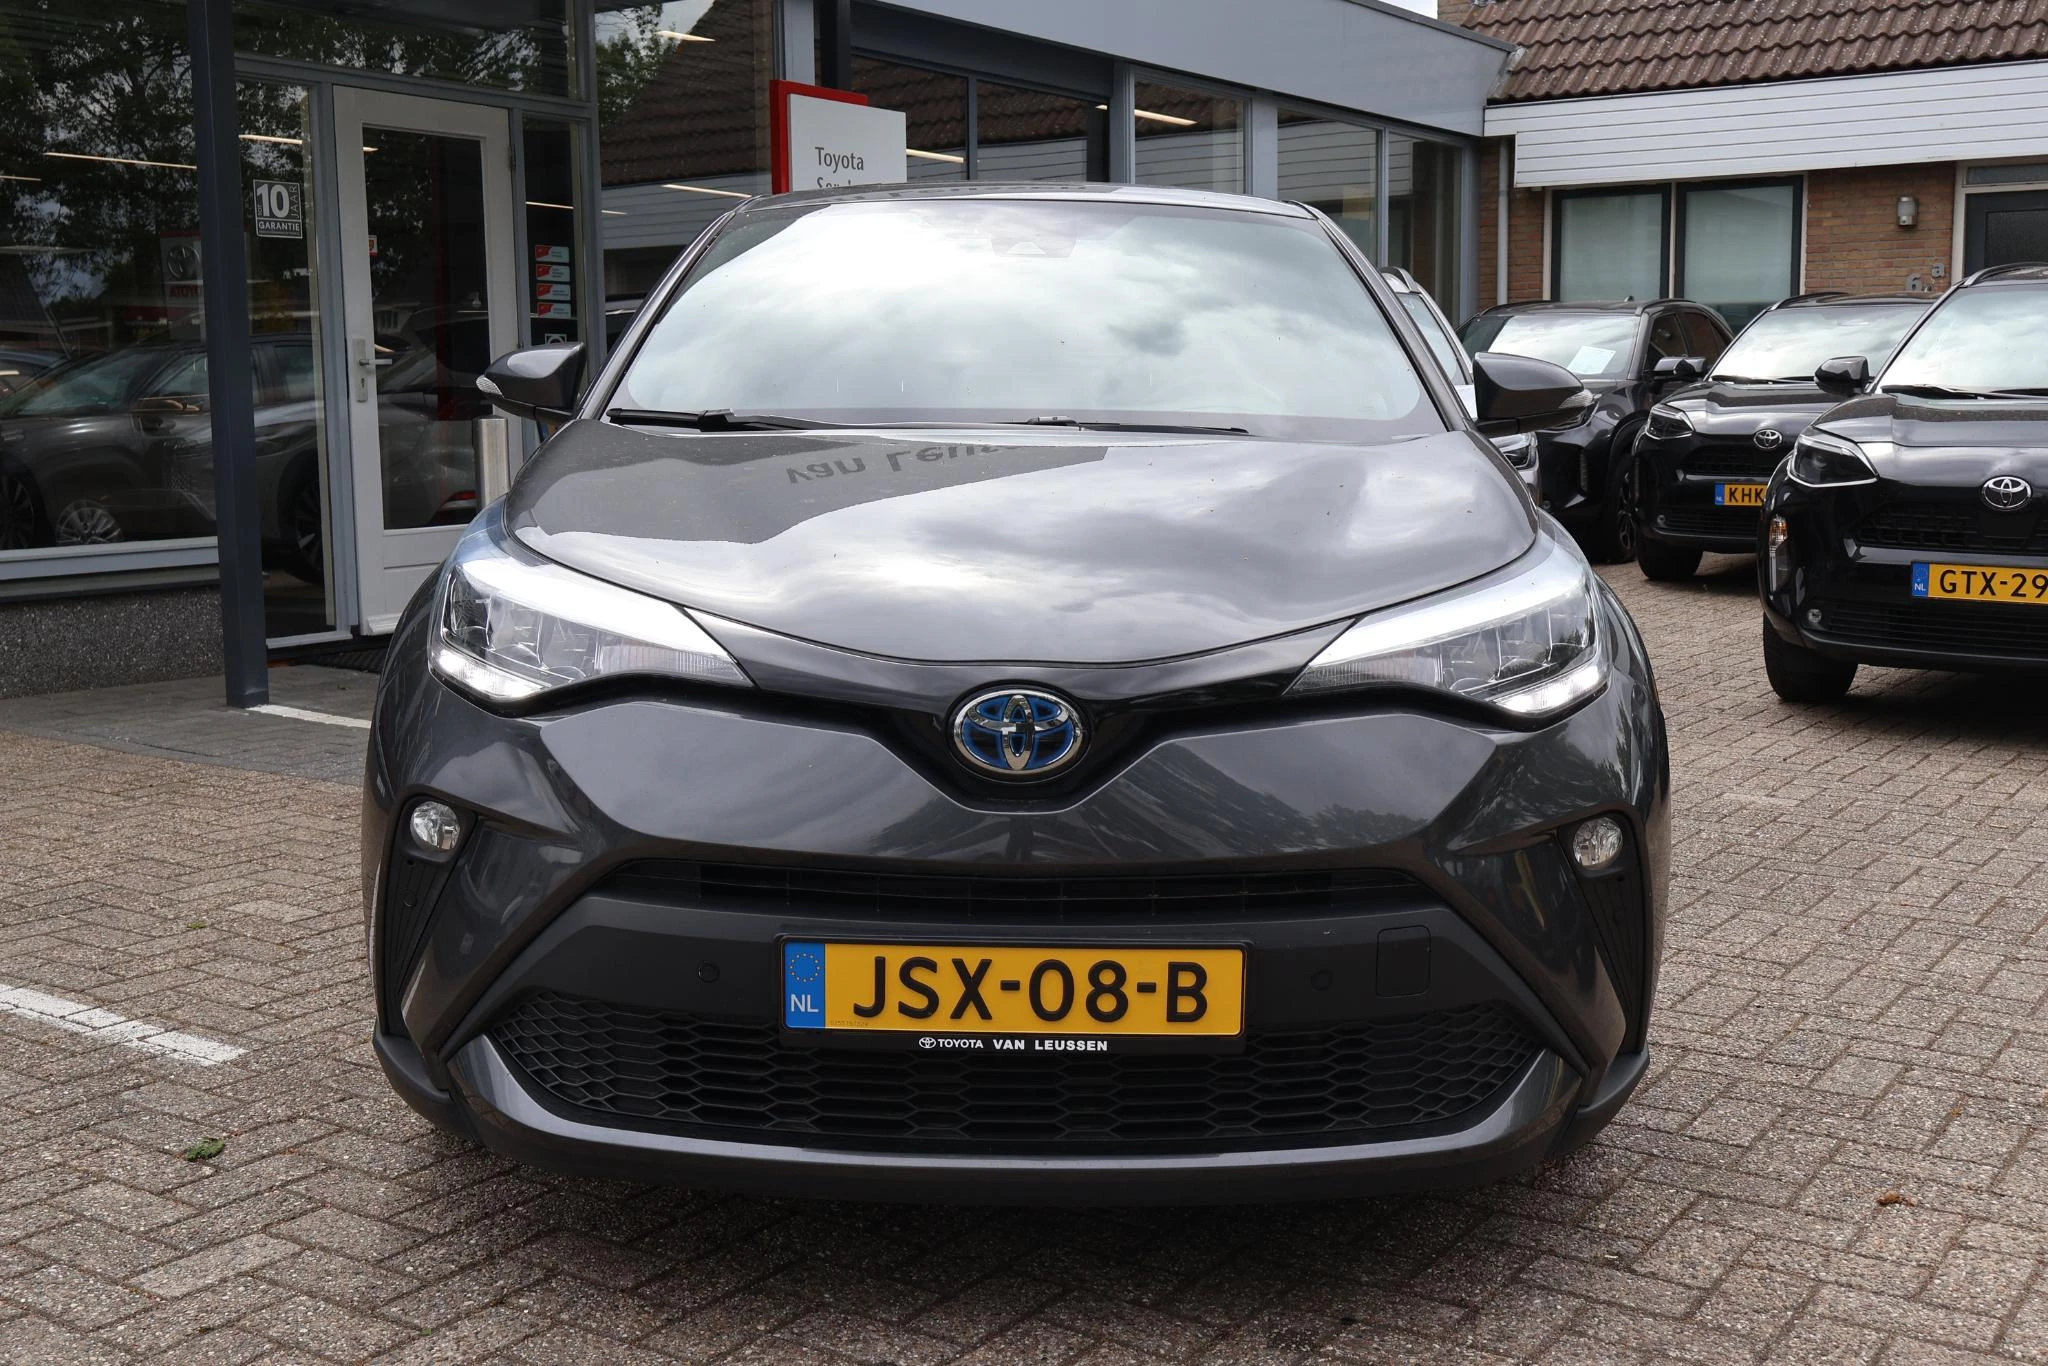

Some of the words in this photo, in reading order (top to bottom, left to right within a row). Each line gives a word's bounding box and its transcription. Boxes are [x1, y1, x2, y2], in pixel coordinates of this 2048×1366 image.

[814, 146, 865, 174] Toyota
[256, 183, 290, 218] 10
[290, 184, 300, 219] JAAR
[258, 220, 300, 232] GARANTIE
[1729, 487, 1765, 503] KHK
[1914, 582, 1926, 591] NL
[1940, 569, 2048, 598] GTX-29
[853, 956, 1208, 1023] JSX-08-B
[790, 993, 819, 1013] NL
[938, 1038, 984, 1049] TOYOTA
[992, 1039, 1025, 1050] VAN
[1034, 1039, 1108, 1051] LEUSSEN
